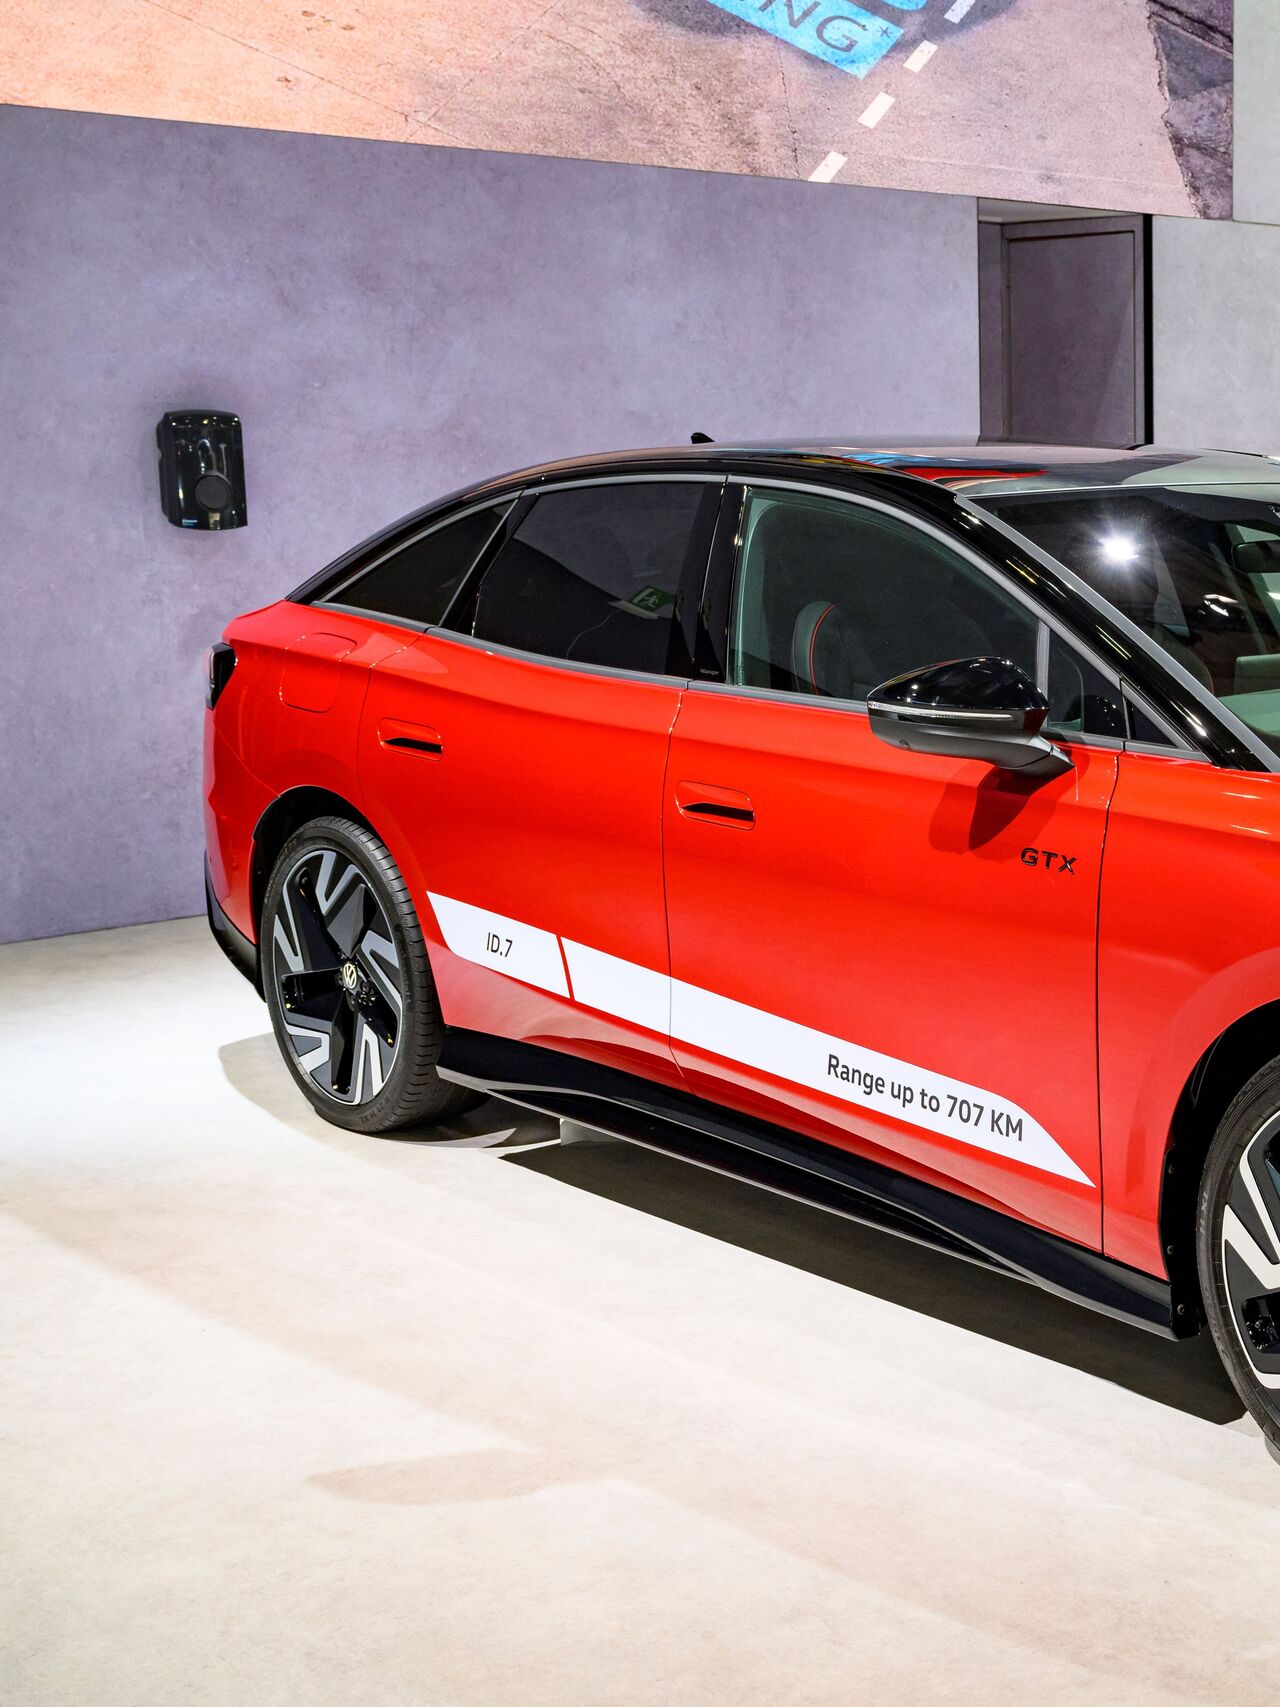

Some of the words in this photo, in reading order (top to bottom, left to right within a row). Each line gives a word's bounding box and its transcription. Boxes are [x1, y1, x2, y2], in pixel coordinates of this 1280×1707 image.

[1021, 847, 1077, 873] GTX
[486, 932, 513, 957] ID.7
[827, 1053, 886, 1096] Range
[890, 1080, 914, 1109] up
[919, 1088, 941, 1113] to
[946, 1094, 985, 1127] 707
[990, 1108, 1024, 1142] KM
